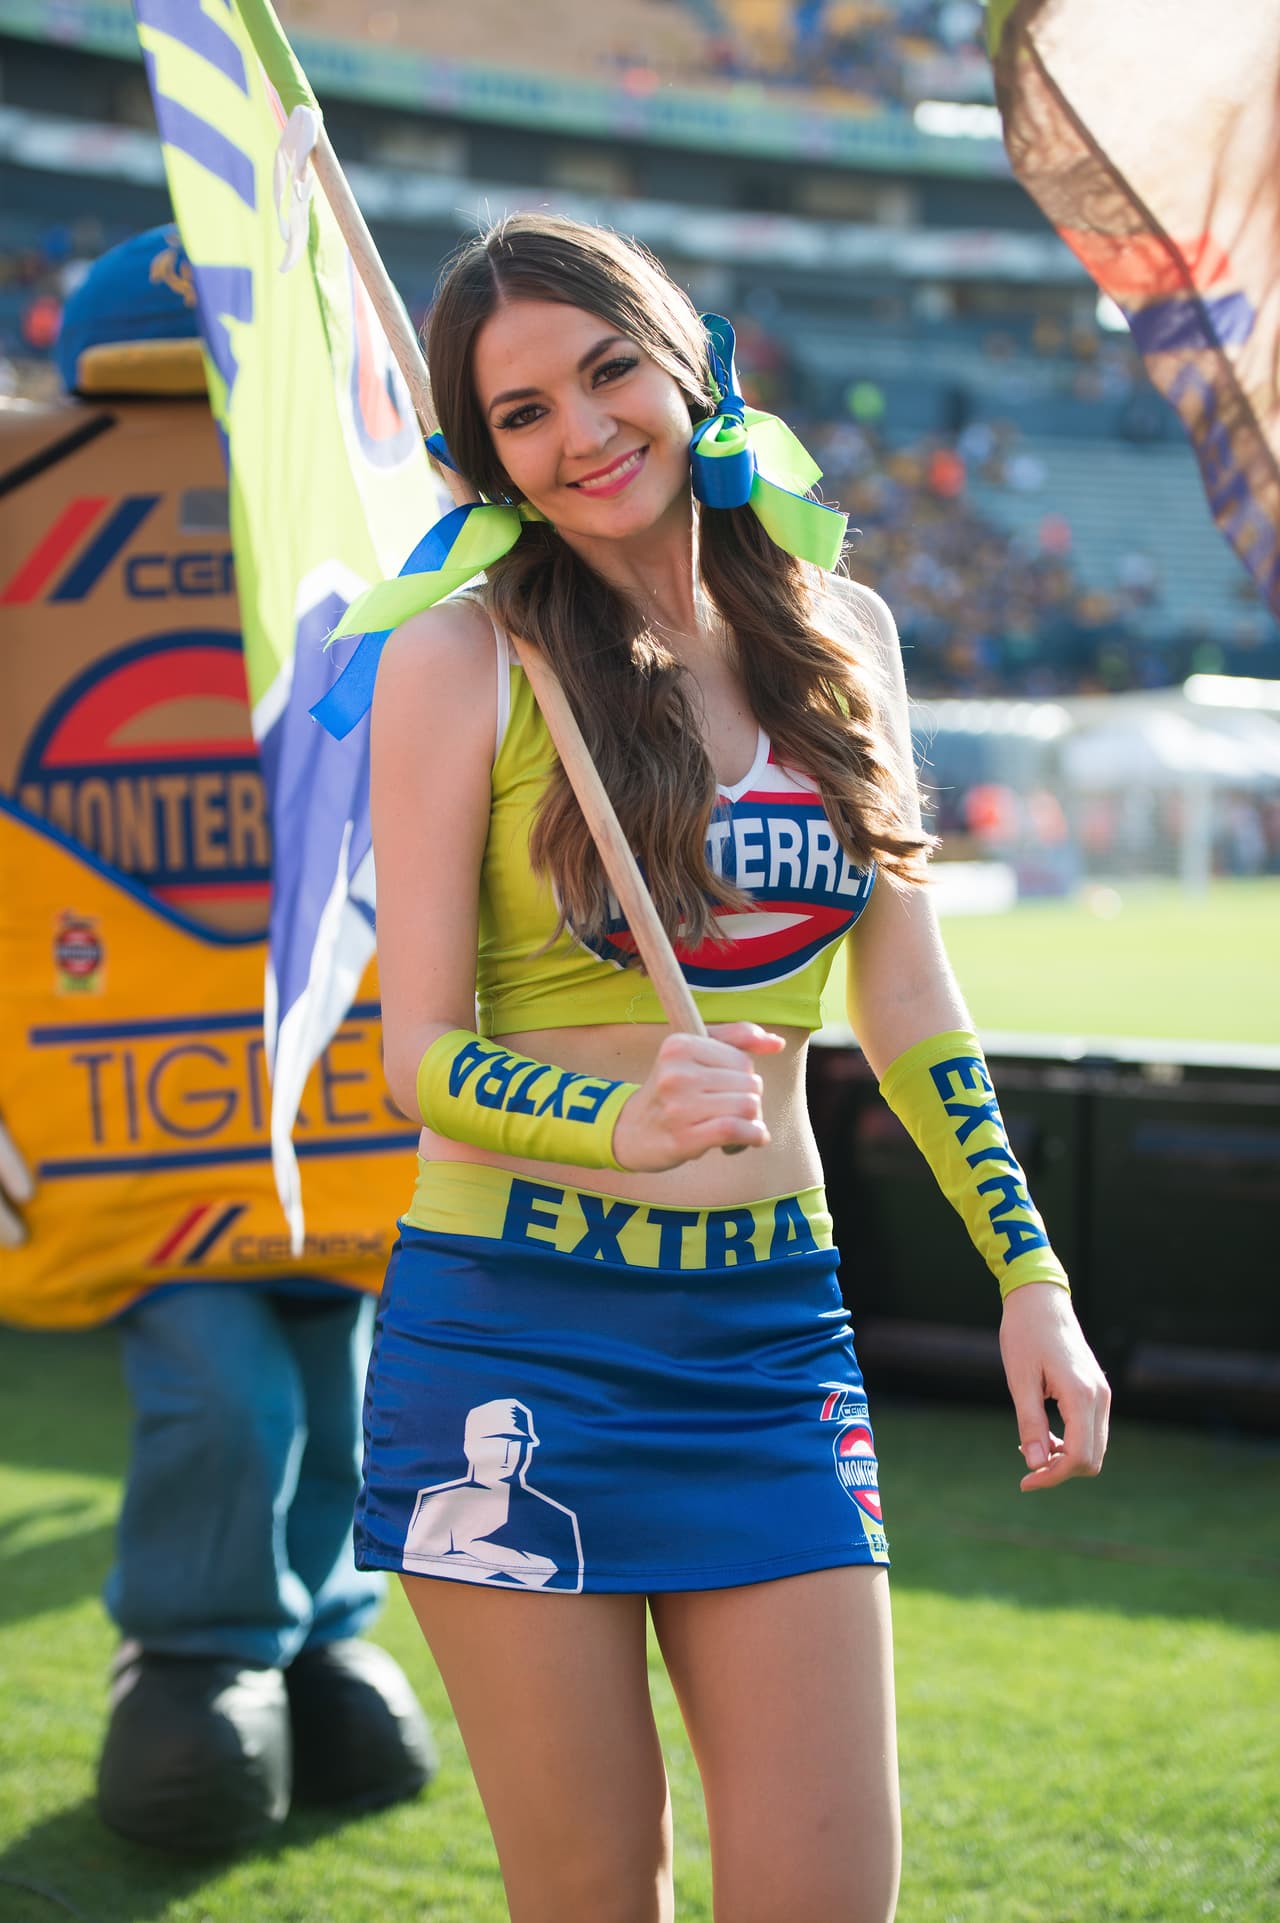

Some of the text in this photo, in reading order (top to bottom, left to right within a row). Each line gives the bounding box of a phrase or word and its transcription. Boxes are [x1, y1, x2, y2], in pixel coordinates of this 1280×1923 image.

[448, 1041, 625, 1124] EXTRA
[928, 1056, 1050, 1265] EXTRA
[501, 1177, 820, 1271] EXTRA
